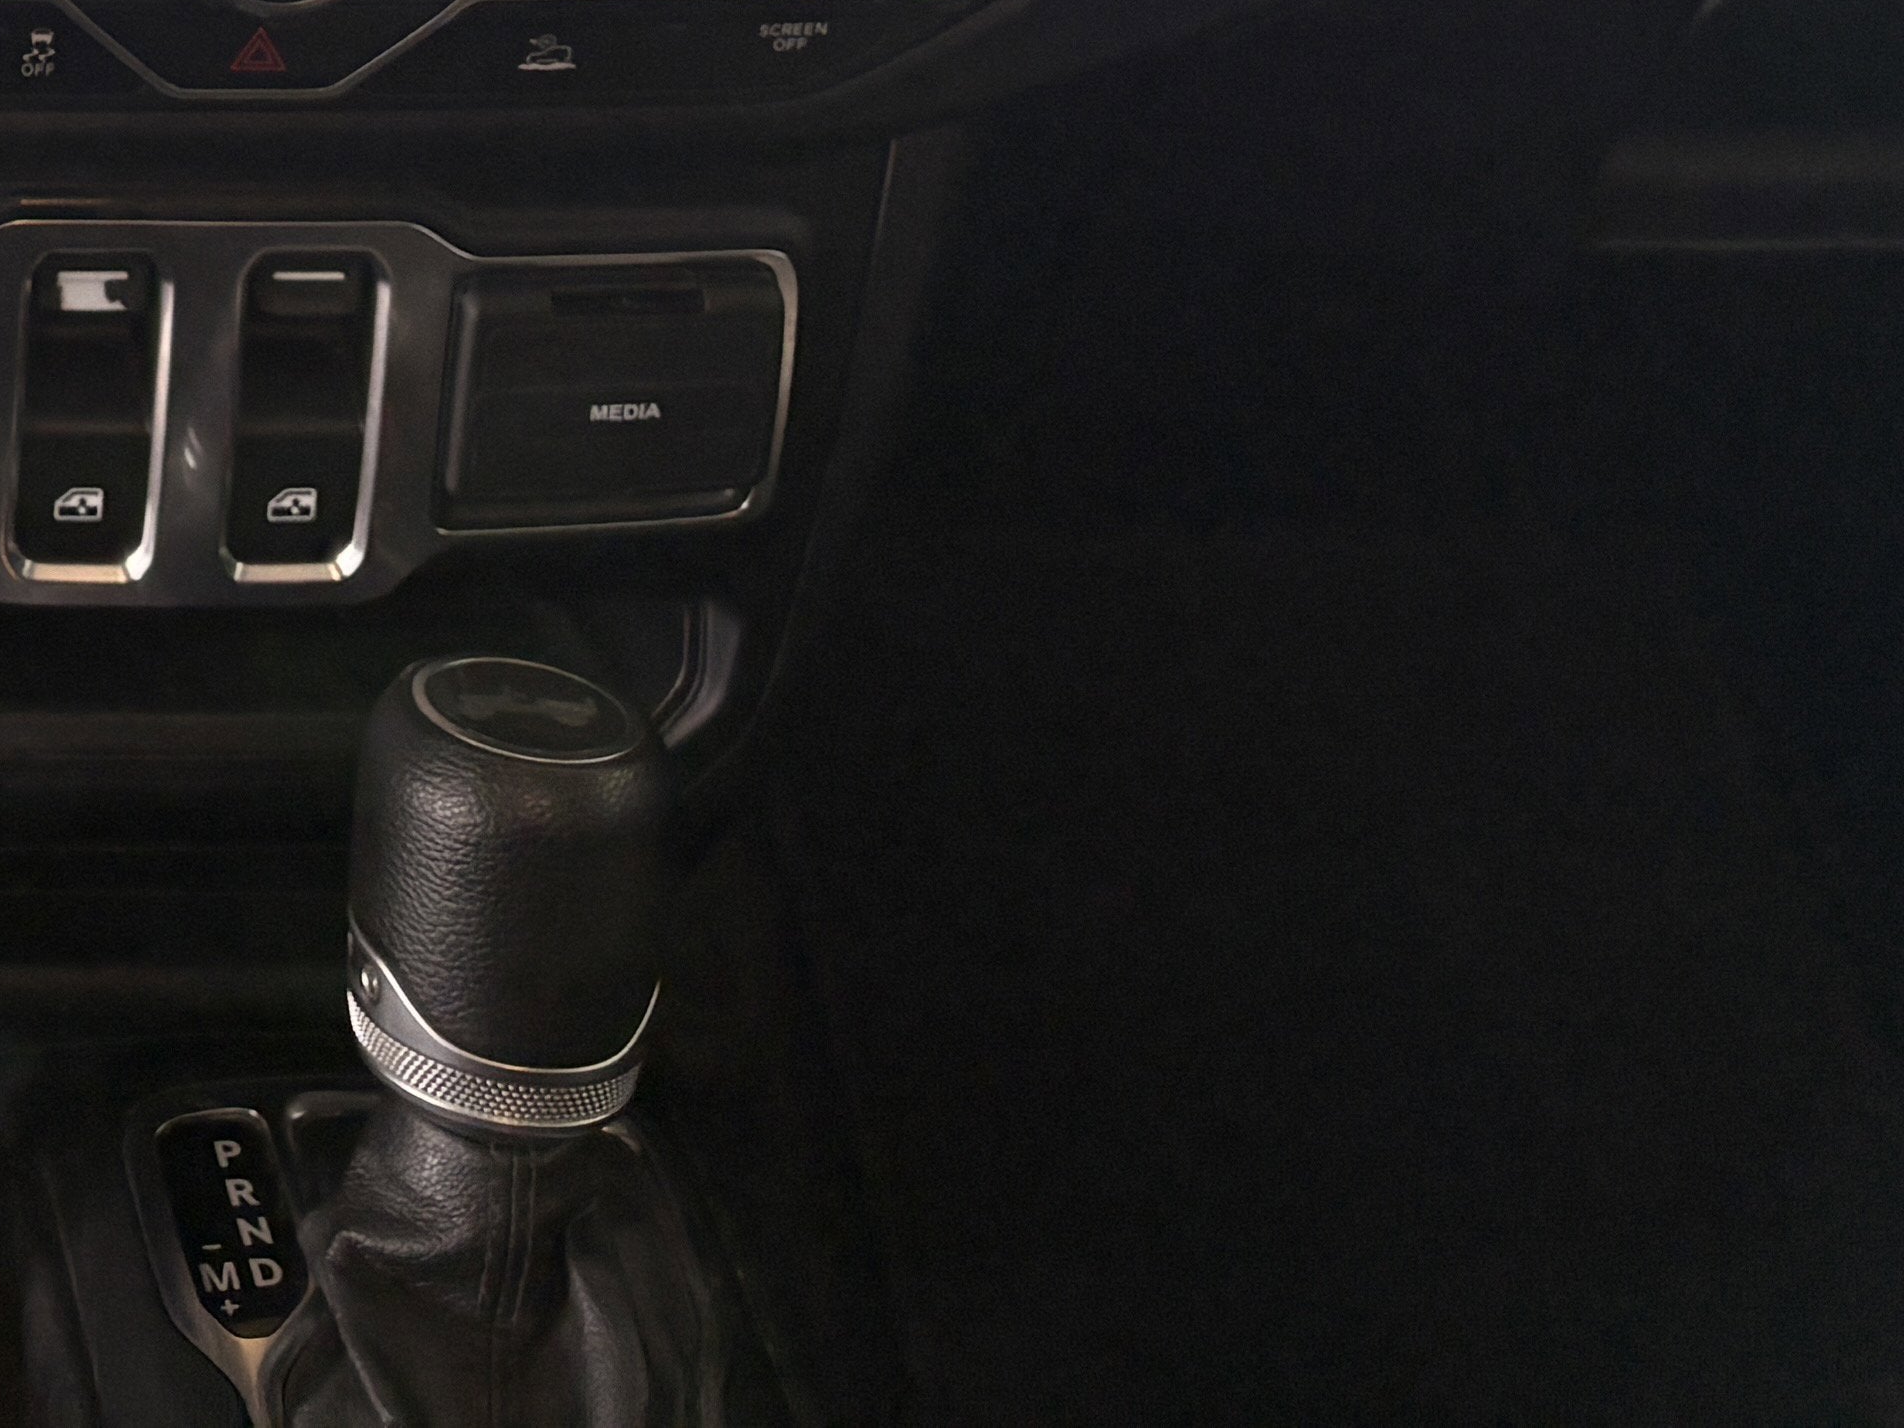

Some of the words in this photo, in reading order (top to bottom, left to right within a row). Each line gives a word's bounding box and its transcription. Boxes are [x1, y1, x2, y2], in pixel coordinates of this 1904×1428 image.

[758, 20, 828, 39] SCREEN
[772, 36, 808, 53] OFF
[21, 62, 55, 78] OFF
[589, 401, 661, 423] MEDIA
[213, 1140, 241, 1168] P
[225, 1178, 260, 1207] R
[236, 1216, 274, 1246] N
[199, 1261, 241, 1293] M
[249, 1257, 283, 1287] D
